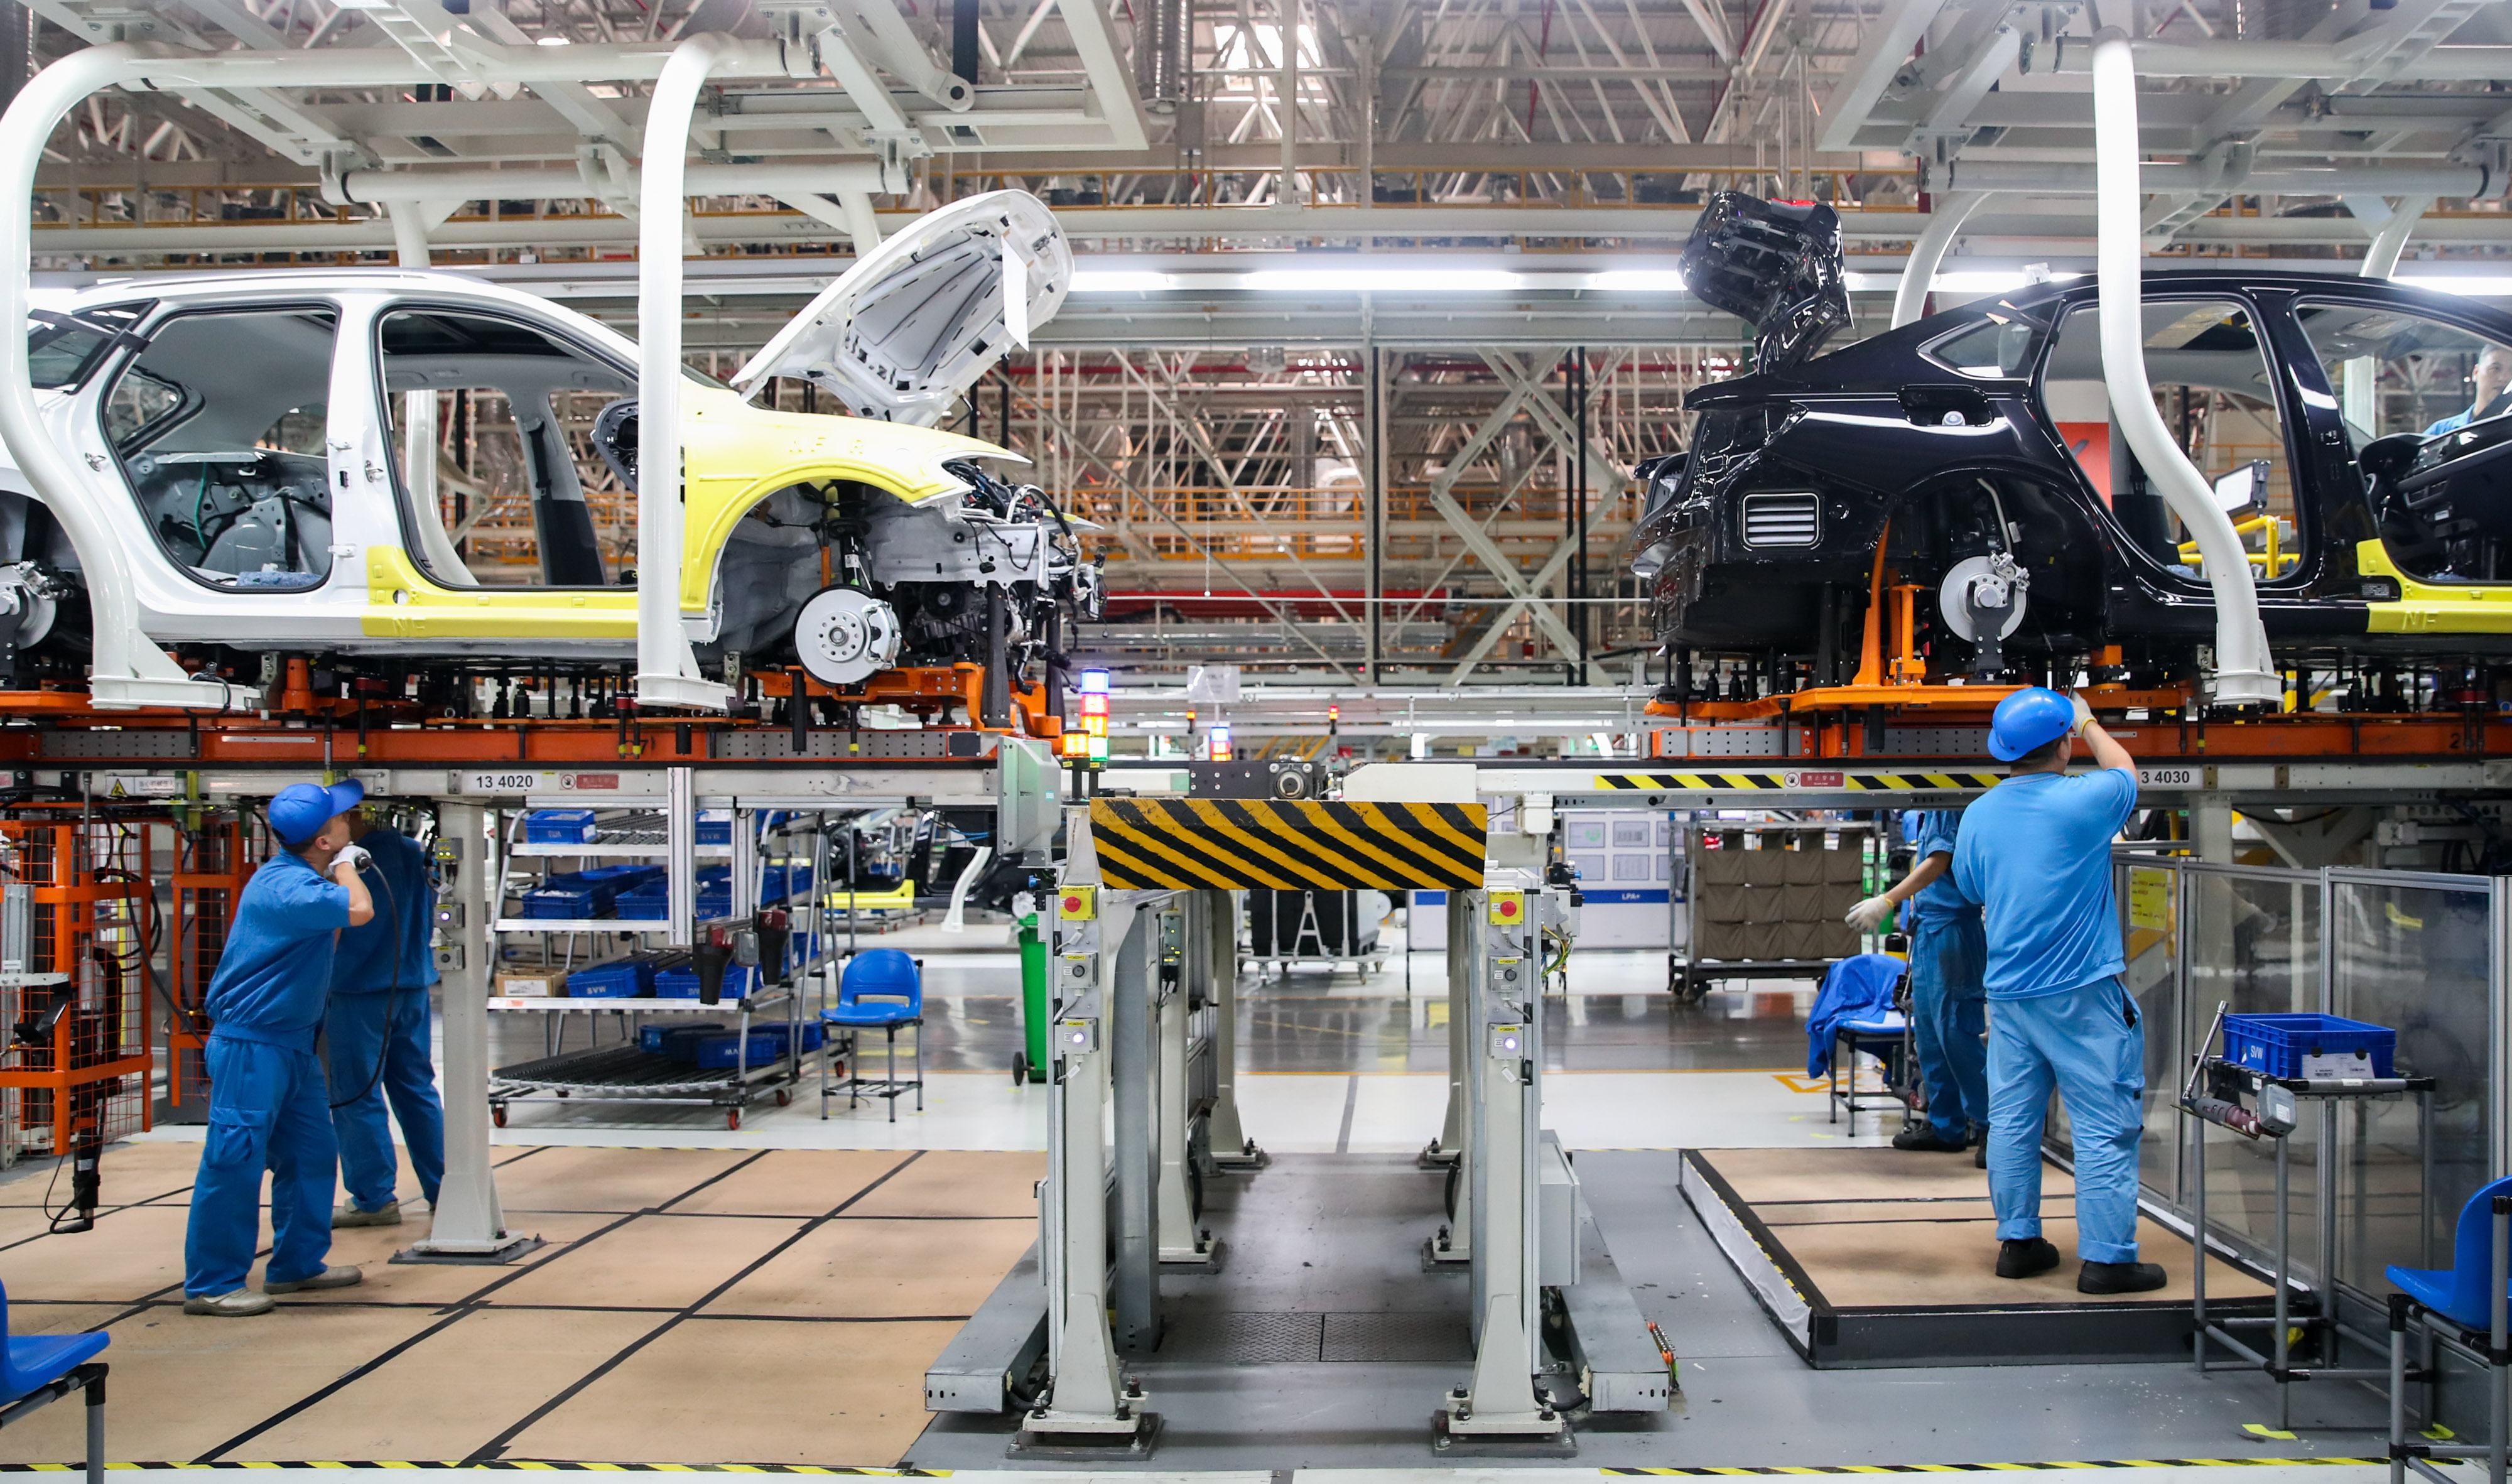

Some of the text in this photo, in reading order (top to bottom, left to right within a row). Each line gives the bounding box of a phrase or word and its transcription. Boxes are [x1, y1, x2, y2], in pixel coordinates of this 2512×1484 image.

[476, 775, 533, 788] 13 4020
[2154, 771, 2190, 783] 4030
[587, 985, 607, 995] SVW
[2250, 1044, 2263, 1060] SVW
